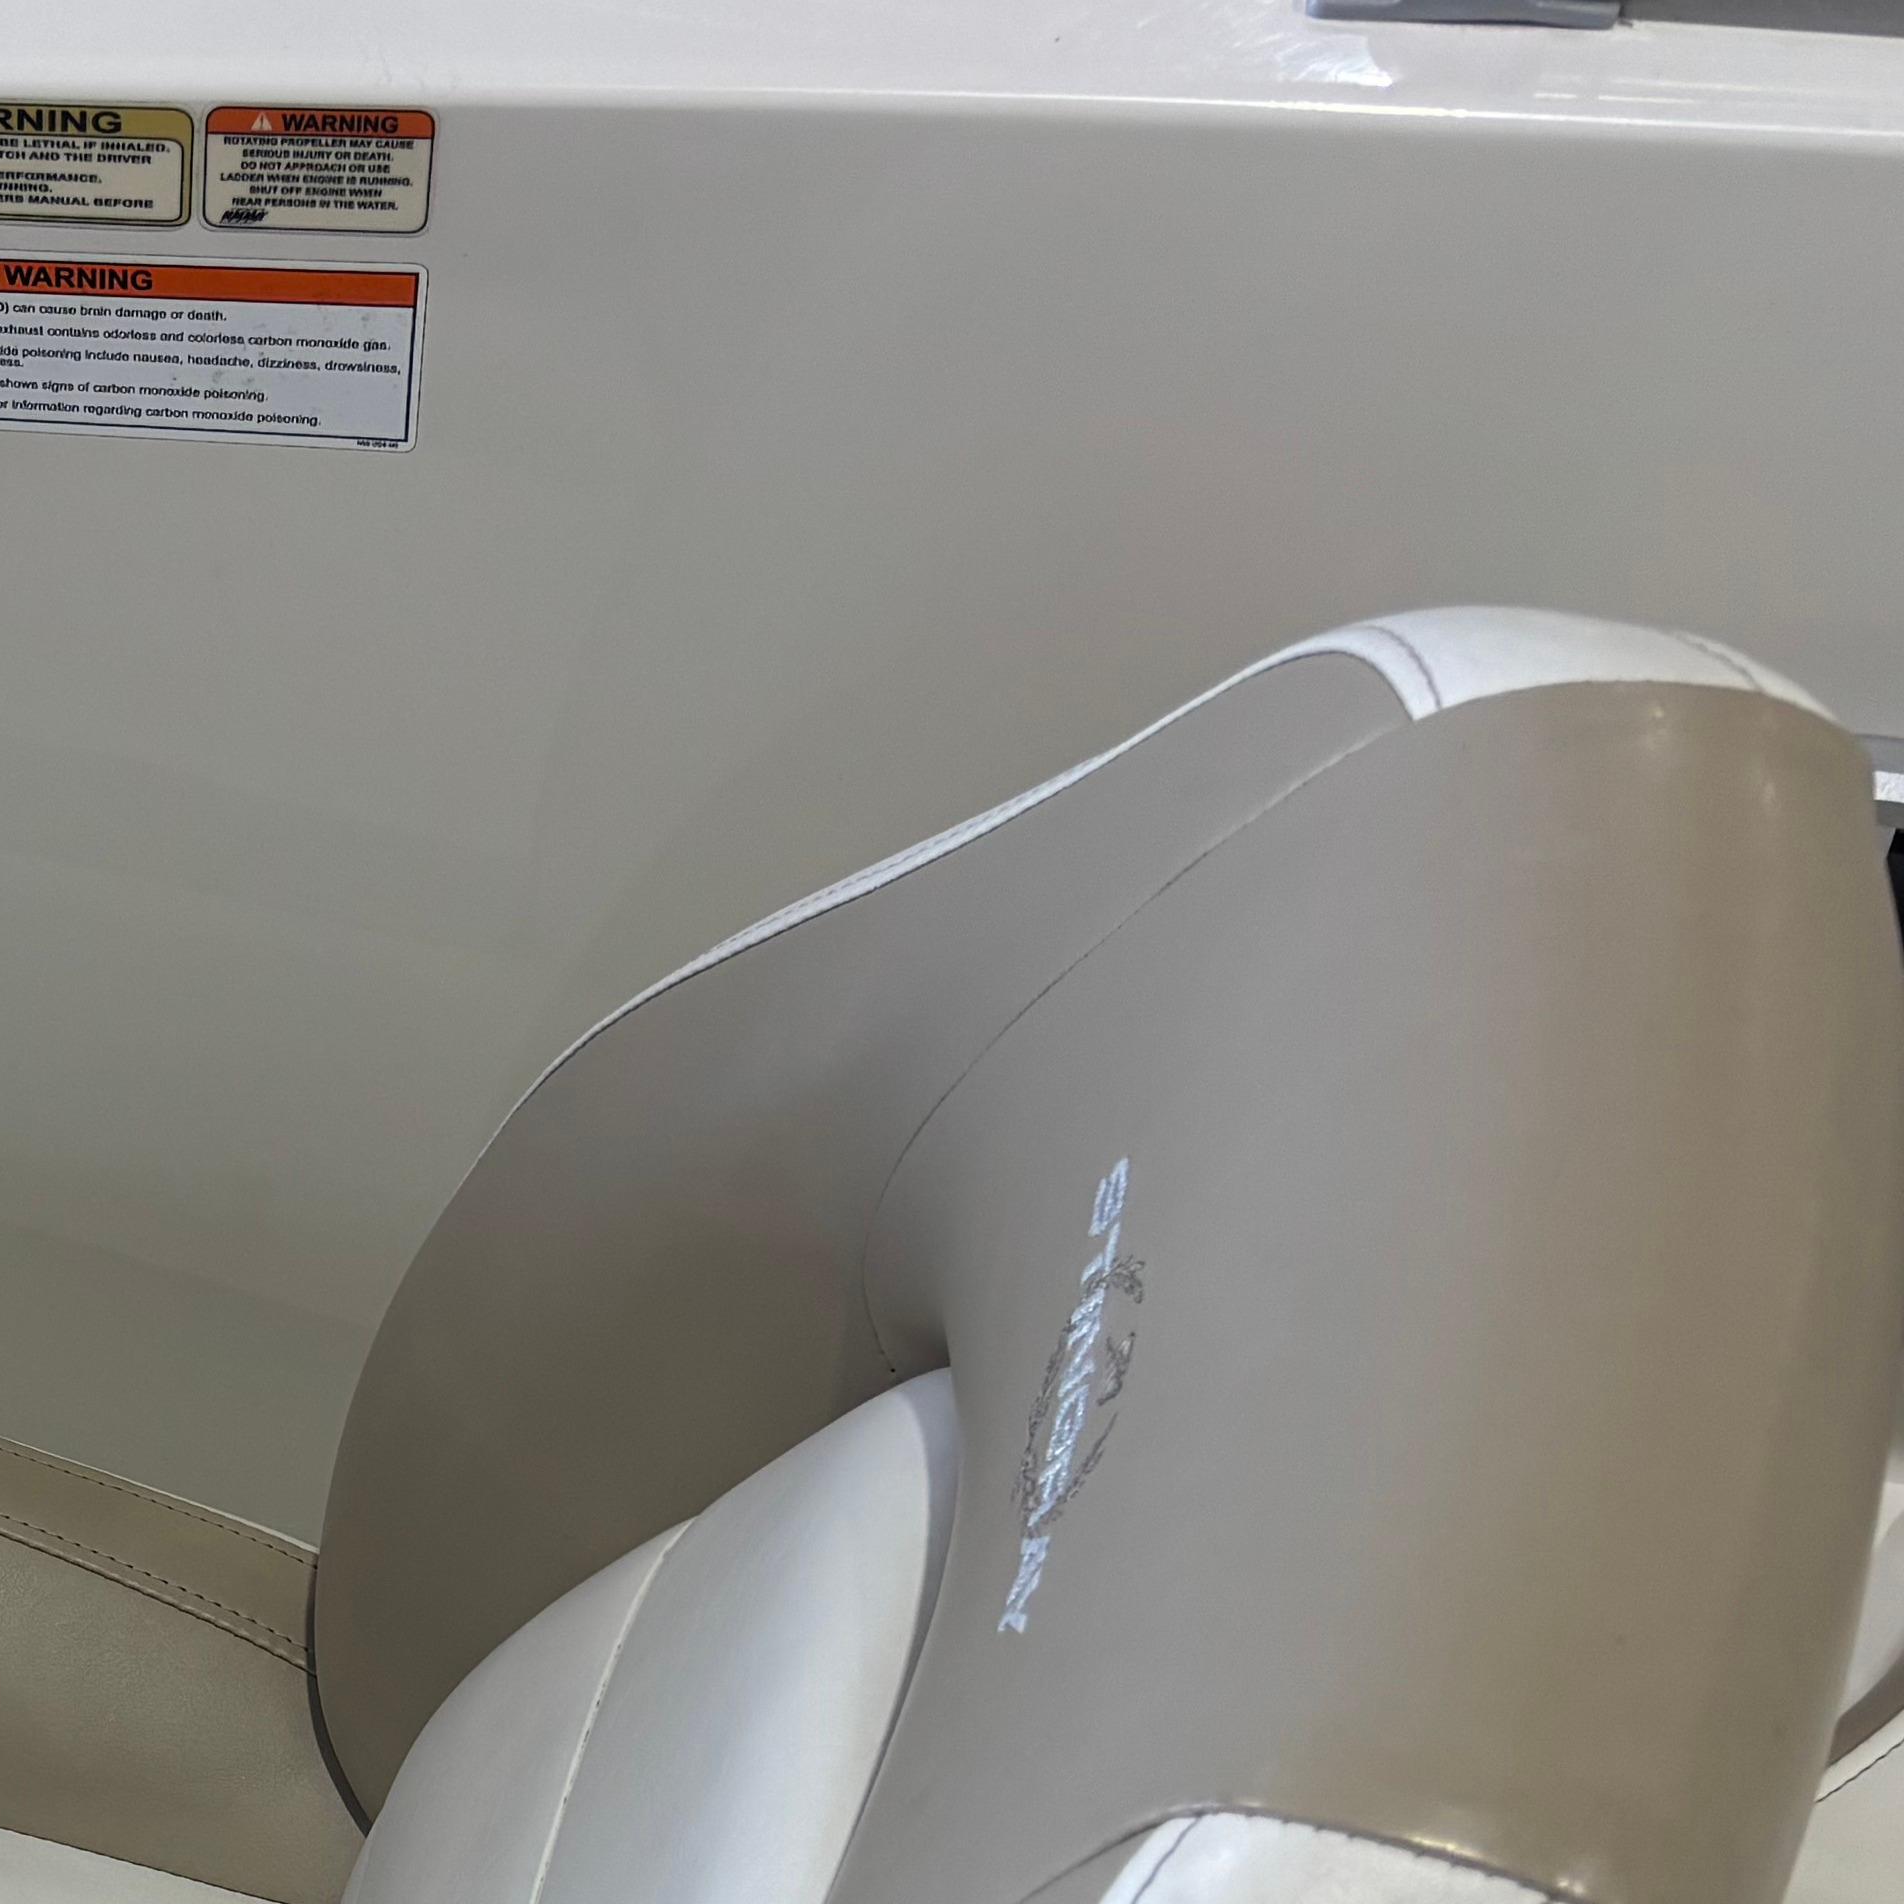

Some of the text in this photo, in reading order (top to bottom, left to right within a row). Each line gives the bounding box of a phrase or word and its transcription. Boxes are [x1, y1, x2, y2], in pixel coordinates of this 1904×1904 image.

[282, 114, 398, 133] WARNING
[4, 264, 153, 291] WARNING
[12, 302, 34, 314] can
[39, 303, 75, 316] cause
[80, 305, 110, 317] brain
[115, 307, 165, 320] damage
[170, 309, 183, 320] or
[47, 325, 99, 338] contains
[103, 328, 155, 340] odorless
[160, 330, 183, 341] and
[188, 331, 244, 343] colorless
[248, 333, 291, 345] carbon
[296, 335, 358, 348] monoxide
[22, 345, 81, 362] poisoning
[85, 349, 129, 361] include
[0, 376, 37, 388] shows
[42, 378, 73, 392] signs
[78, 379, 89, 391] of
[93, 380, 135, 393] carbon
[139, 383, 199, 397] monoxide
[12, 398, 79, 412] information
[83, 402, 141, 417] regarding
[145, 405, 188, 418] carbon
[192, 408, 252, 421] monoxide
